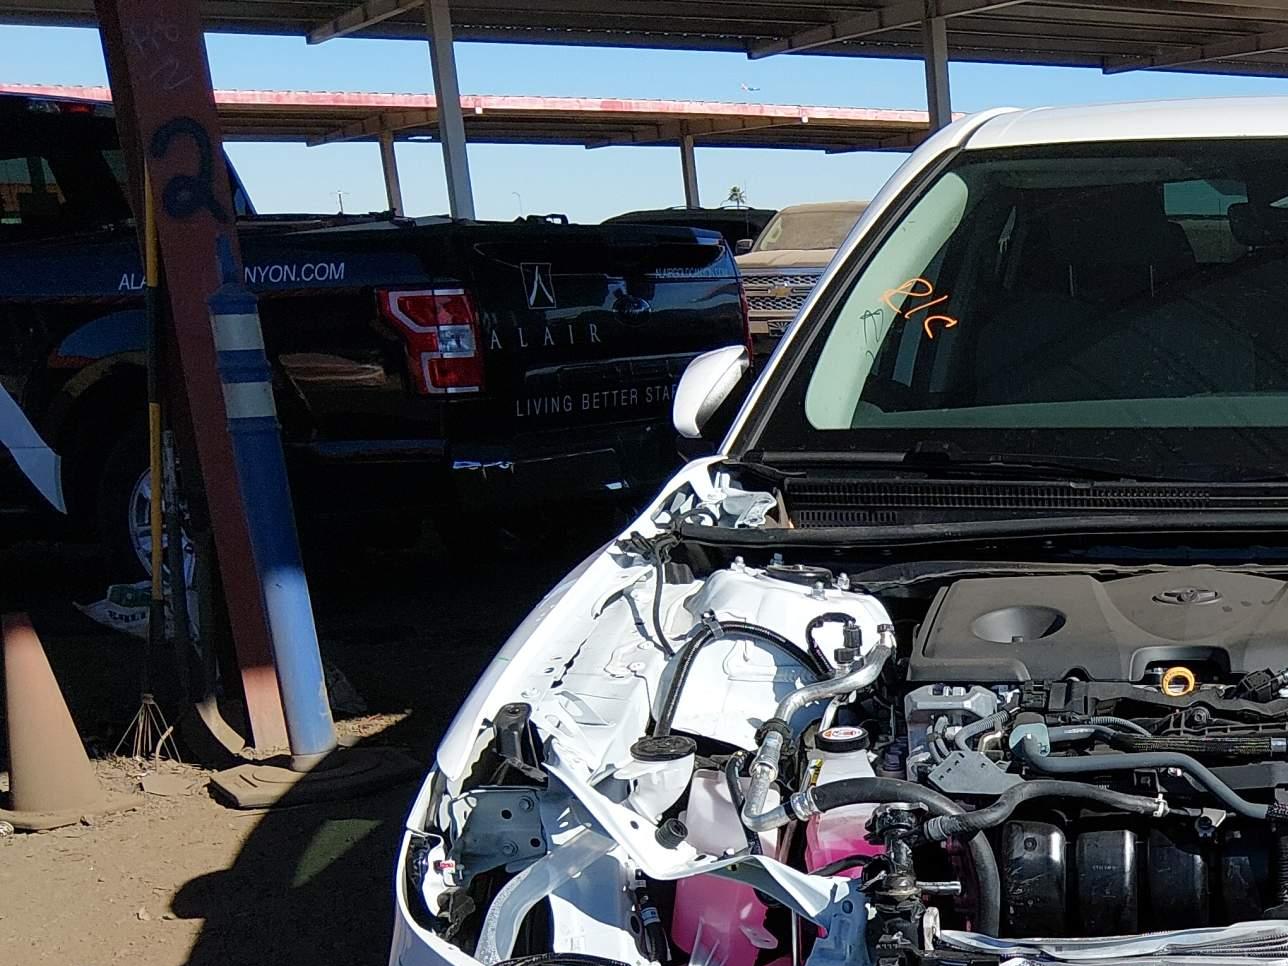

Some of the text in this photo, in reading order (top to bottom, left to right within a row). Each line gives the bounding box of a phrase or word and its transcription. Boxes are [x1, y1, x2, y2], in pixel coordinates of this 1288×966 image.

[490, 323, 602, 350] ALAIR
[516, 395, 573, 418] LIVING
[581, 389, 638, 411] BETTER
